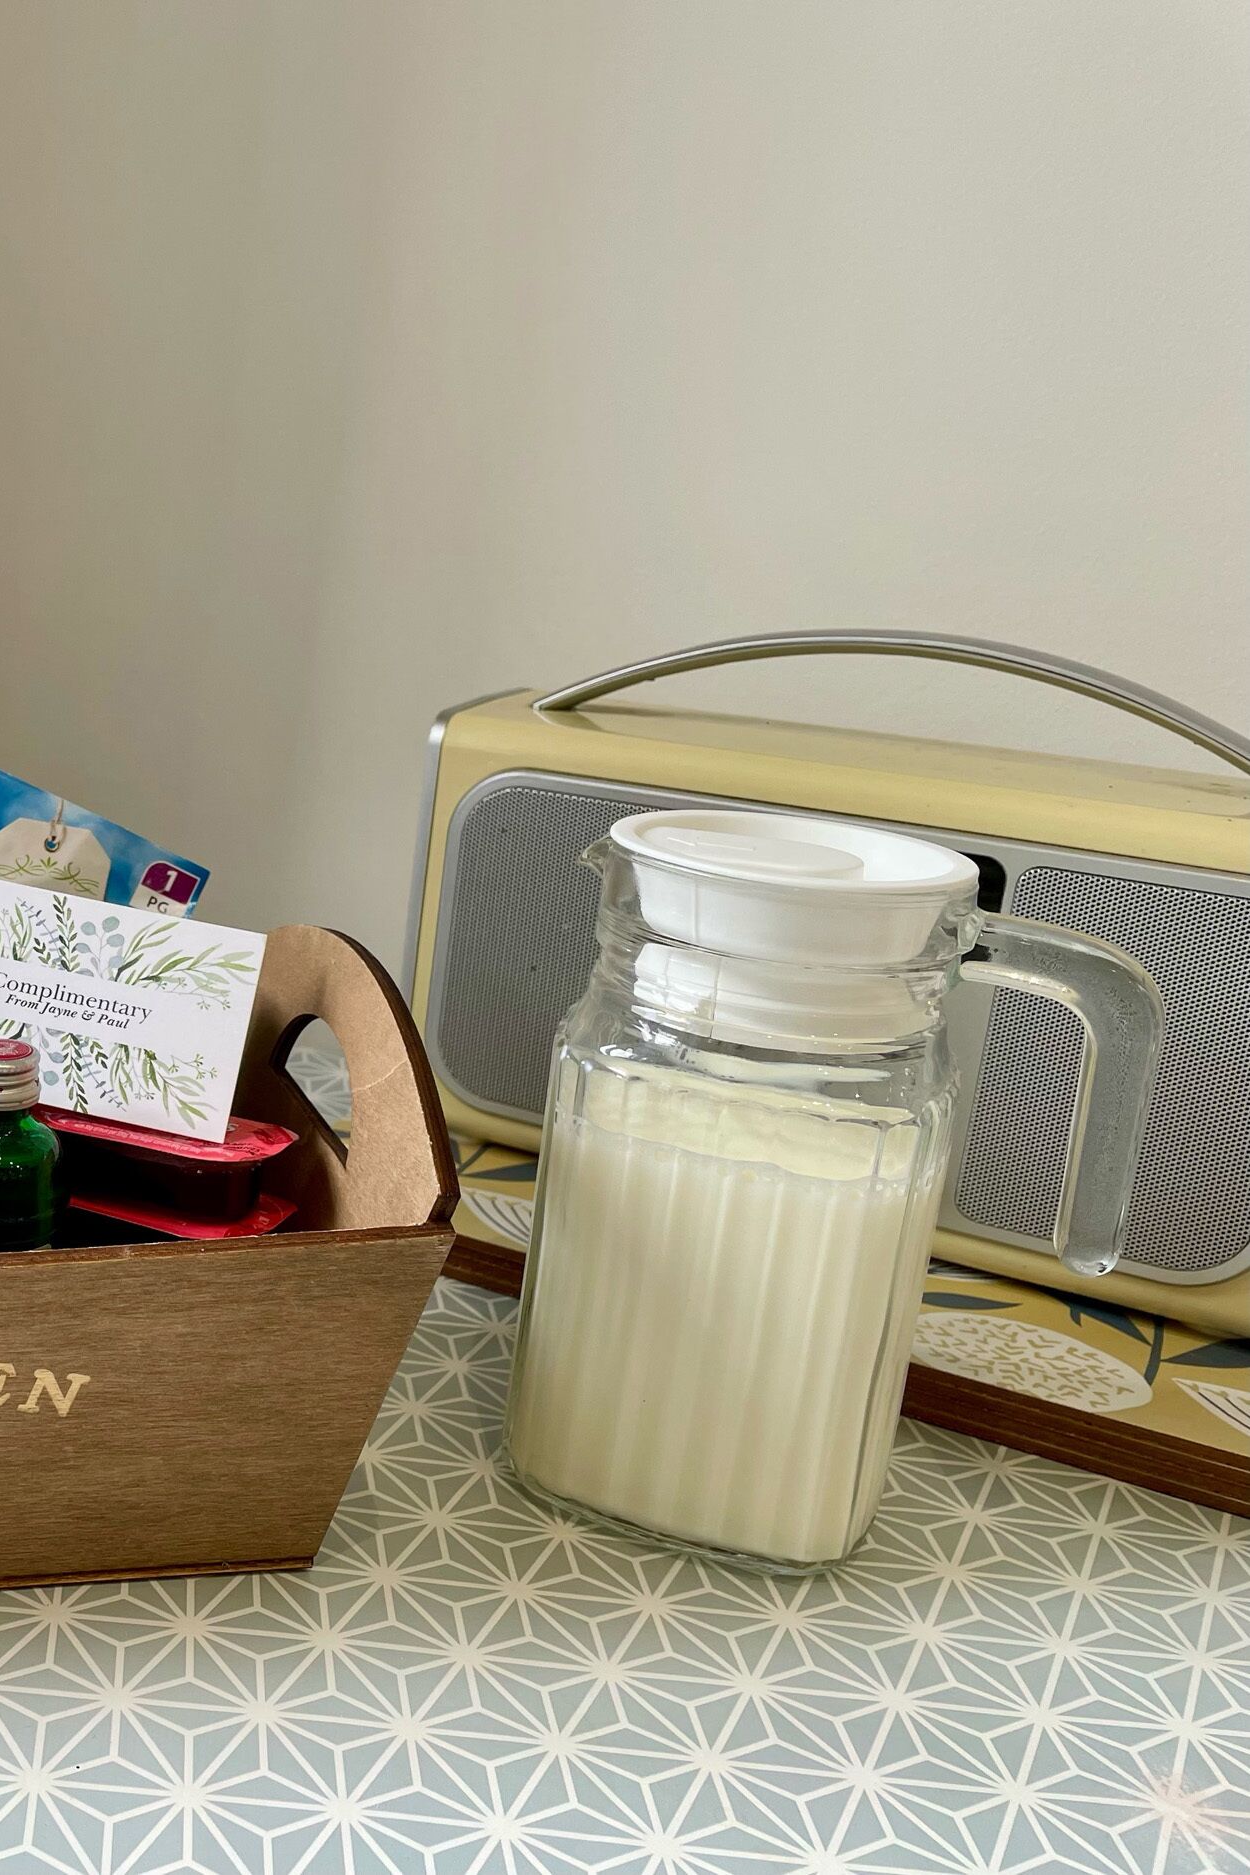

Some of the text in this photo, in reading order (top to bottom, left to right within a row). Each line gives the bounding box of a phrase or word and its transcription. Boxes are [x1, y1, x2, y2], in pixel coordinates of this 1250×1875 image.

[164, 870, 178, 892] 1
[5, 993, 130, 1030] From Jayne & Paul
